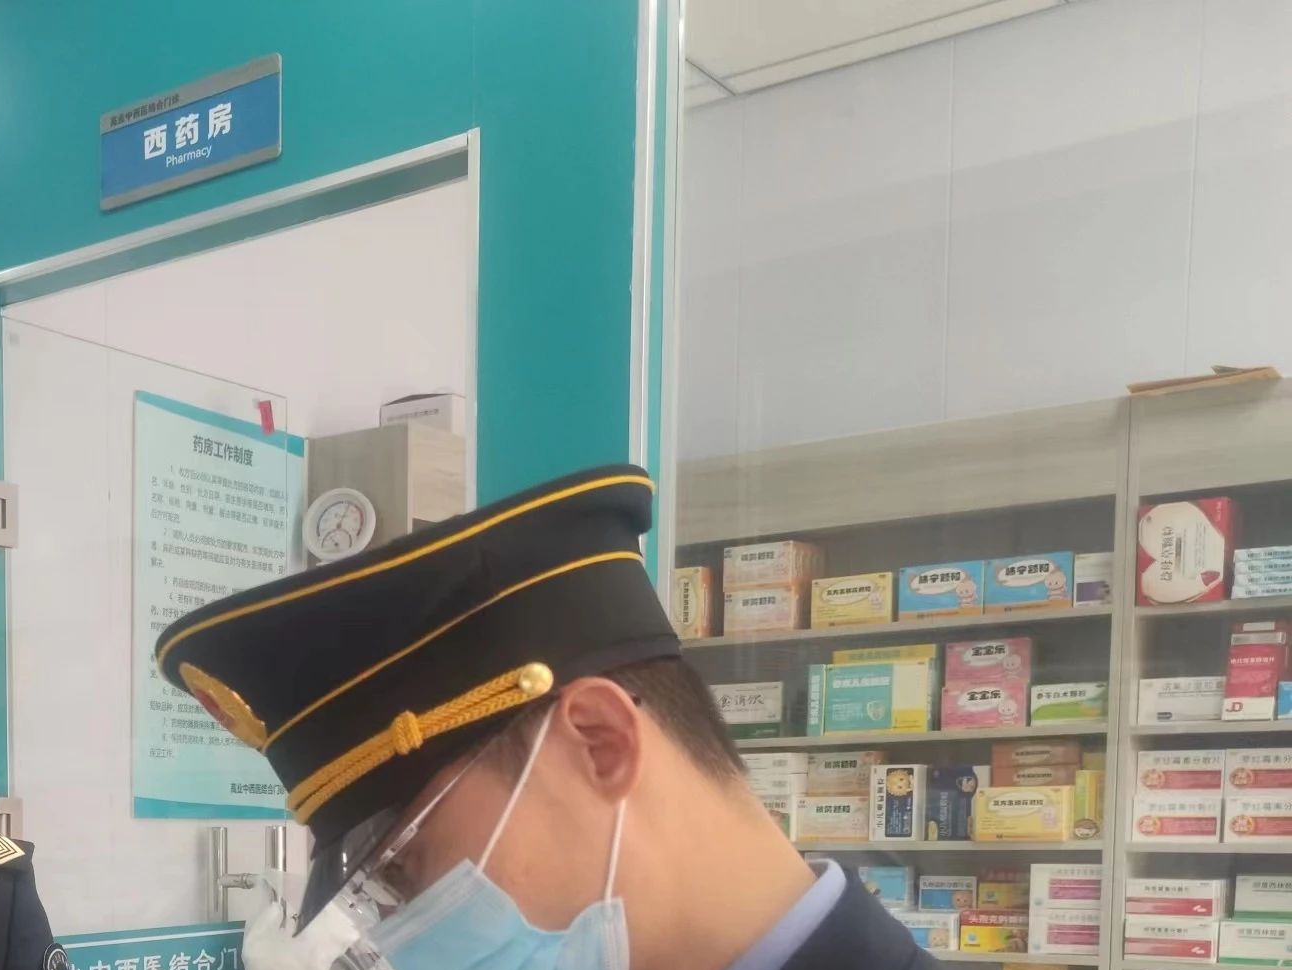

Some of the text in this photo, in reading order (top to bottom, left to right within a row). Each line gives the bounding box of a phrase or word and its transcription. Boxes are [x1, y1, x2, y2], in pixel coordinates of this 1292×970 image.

[144, 102, 233, 160] 西药房
[166, 145, 212, 168] Pharmacy
[193, 435, 254, 467] 药房工作制度
